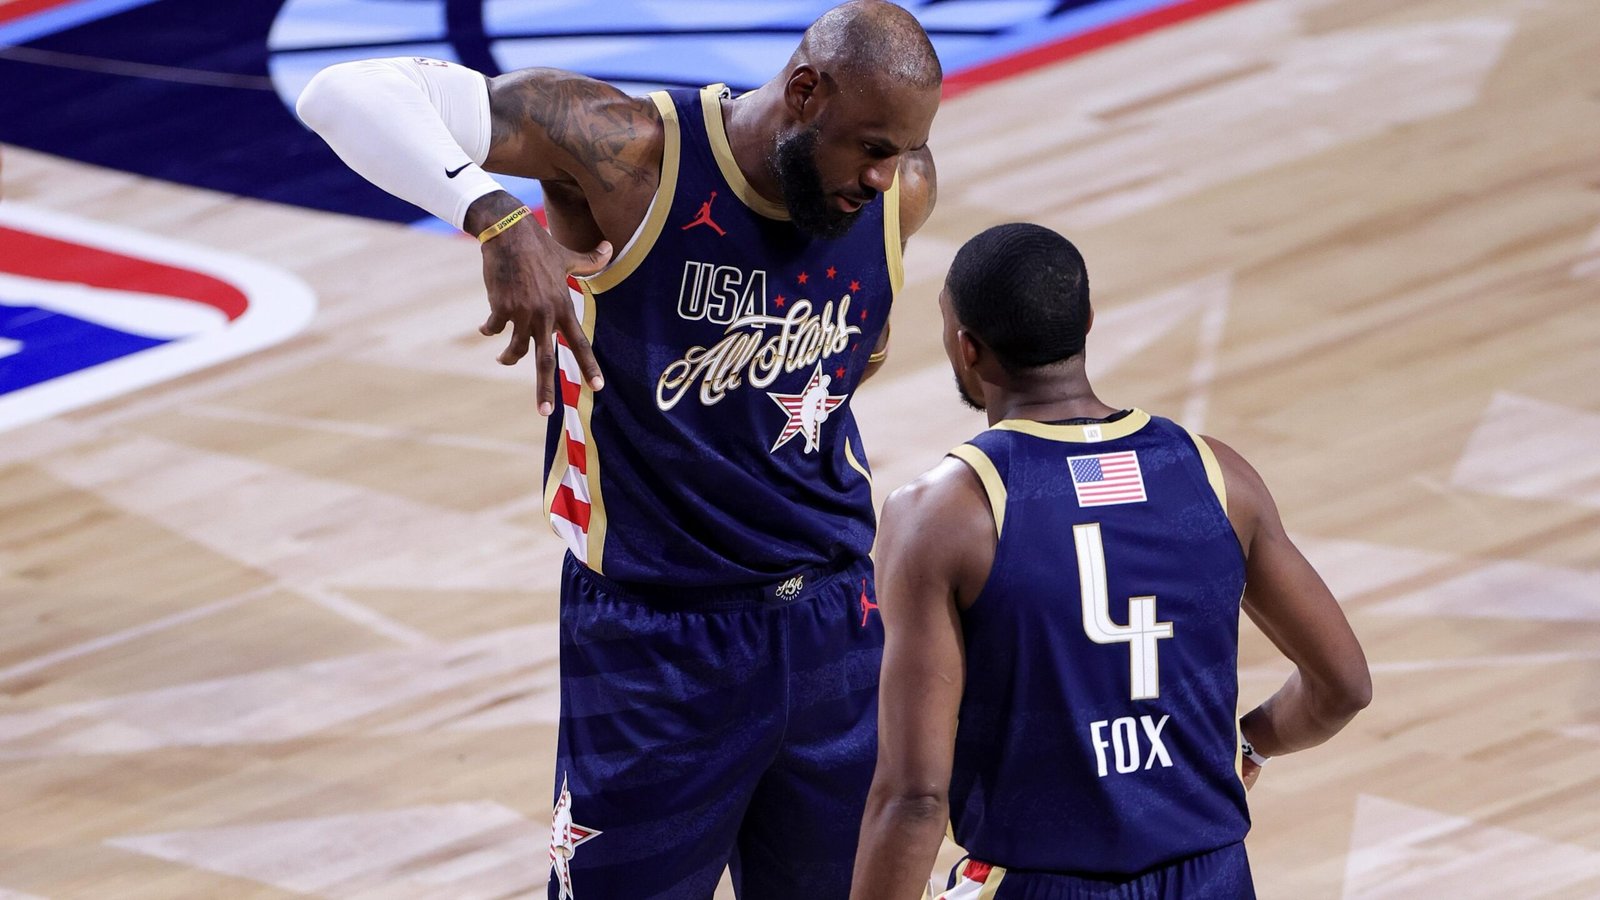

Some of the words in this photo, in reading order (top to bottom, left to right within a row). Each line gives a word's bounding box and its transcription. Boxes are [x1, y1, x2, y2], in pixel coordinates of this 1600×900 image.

[677, 261, 766, 328] USA
[656, 329, 763, 411] All
[724, 294, 861, 388] Stars
[1072, 522, 1174, 700] 4
[1090, 714, 1174, 777] FOX
